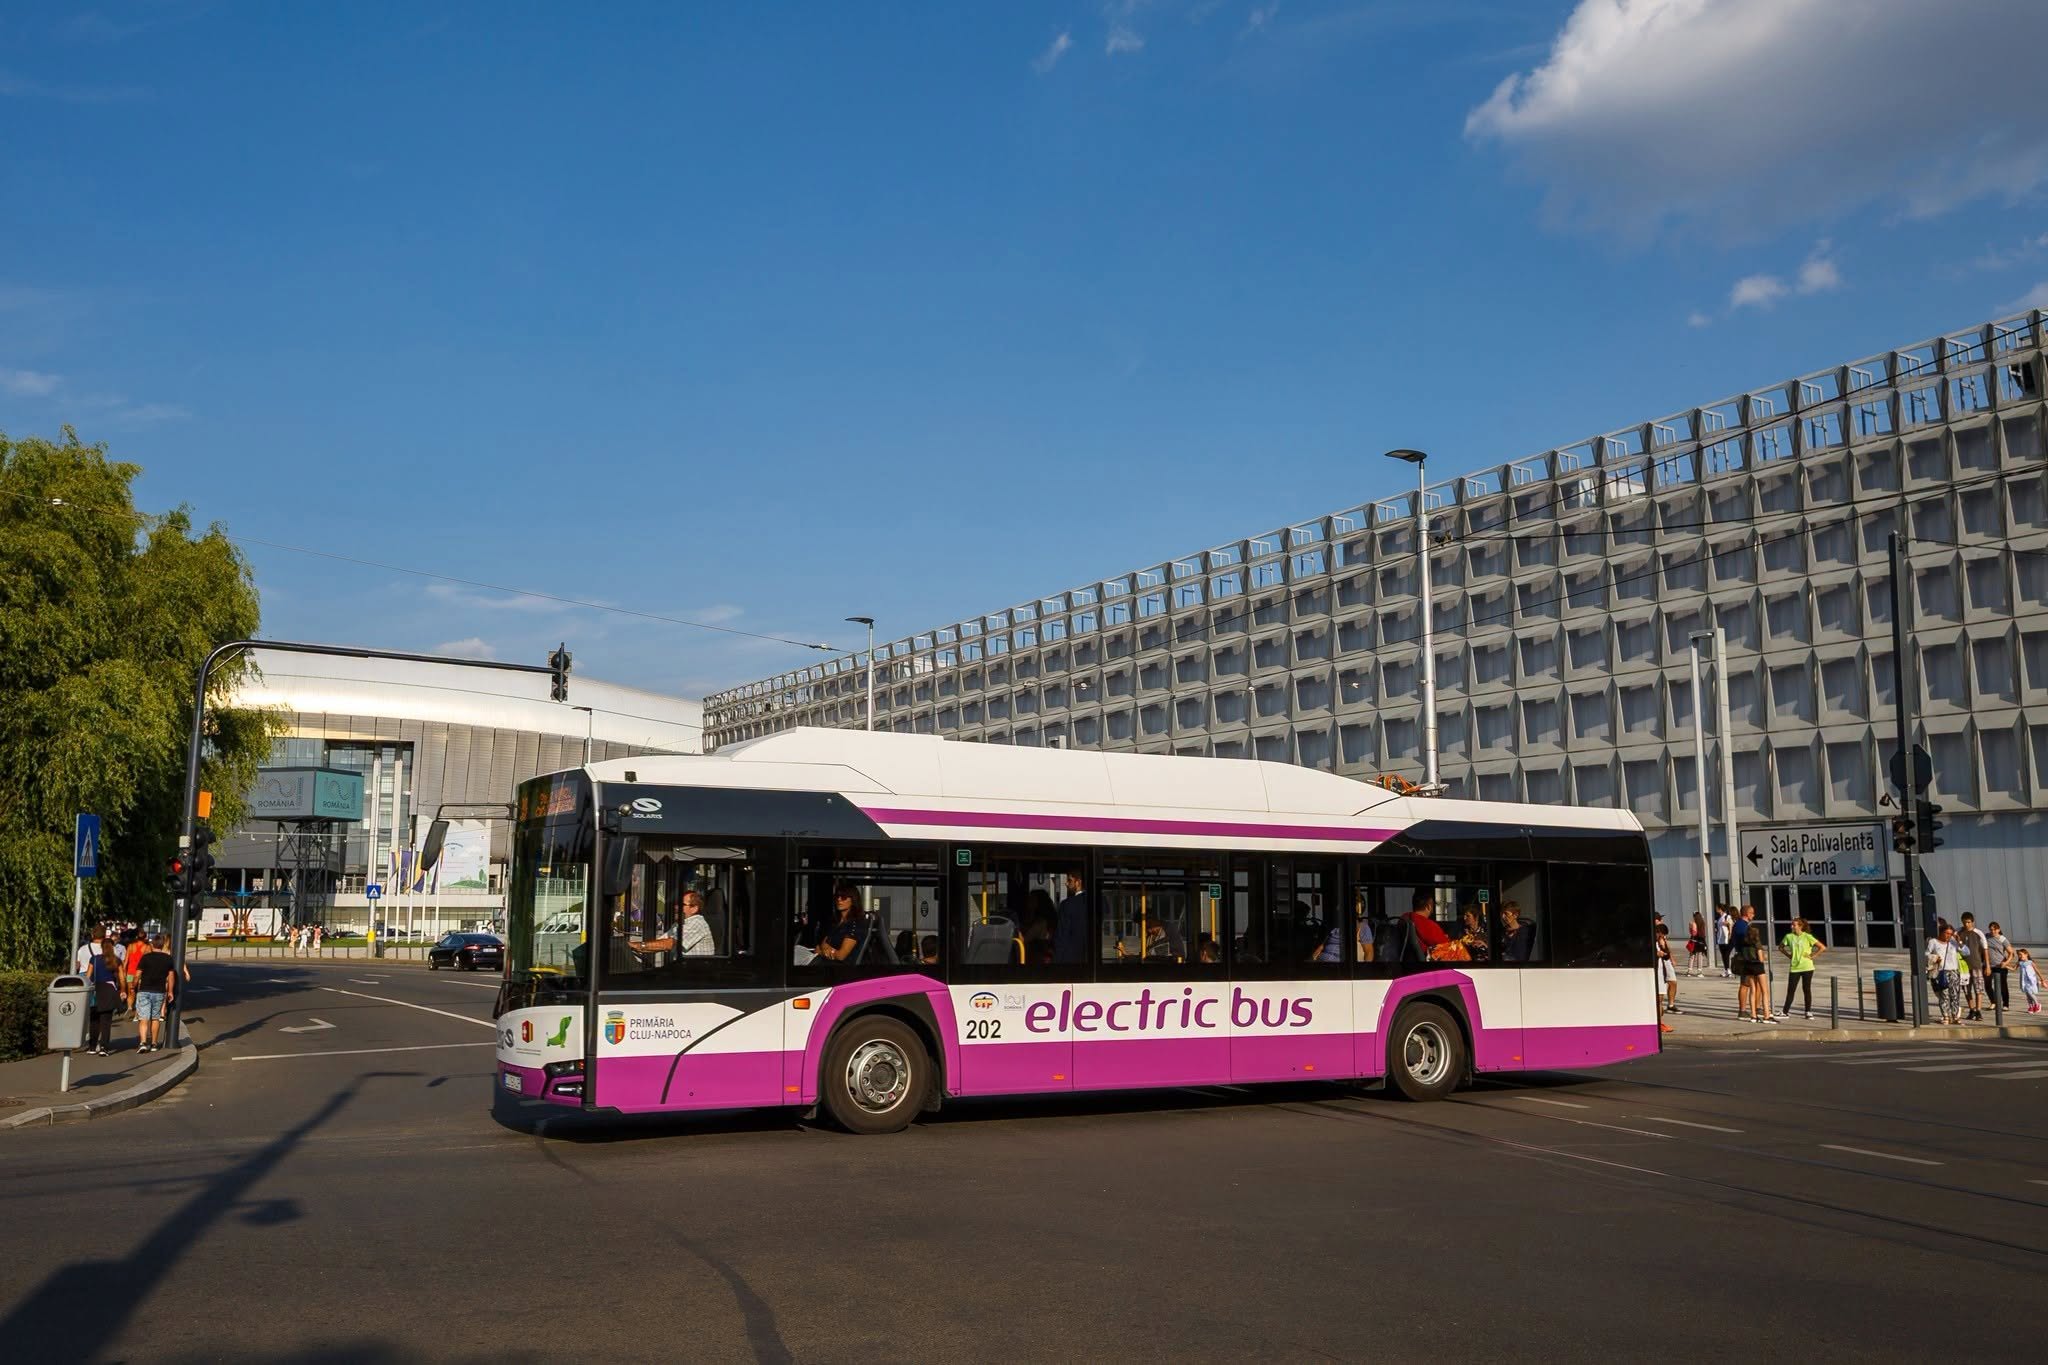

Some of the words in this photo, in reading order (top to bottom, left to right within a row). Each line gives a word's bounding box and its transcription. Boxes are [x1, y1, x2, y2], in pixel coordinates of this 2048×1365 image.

[1771, 836, 1798, 854] Sala
[1802, 832, 1874, 853] Polivalentă
[1771, 858, 1795, 880] Cluj
[1799, 857, 1837, 876] Arena
[1024, 987, 1219, 1033] electric
[1231, 986, 1313, 1028] bus
[630, 1017, 674, 1028] PRIMĂRIA
[966, 1019, 1002, 1039] 202
[630, 1029, 692, 1040] CLUJ-NAPOCA
